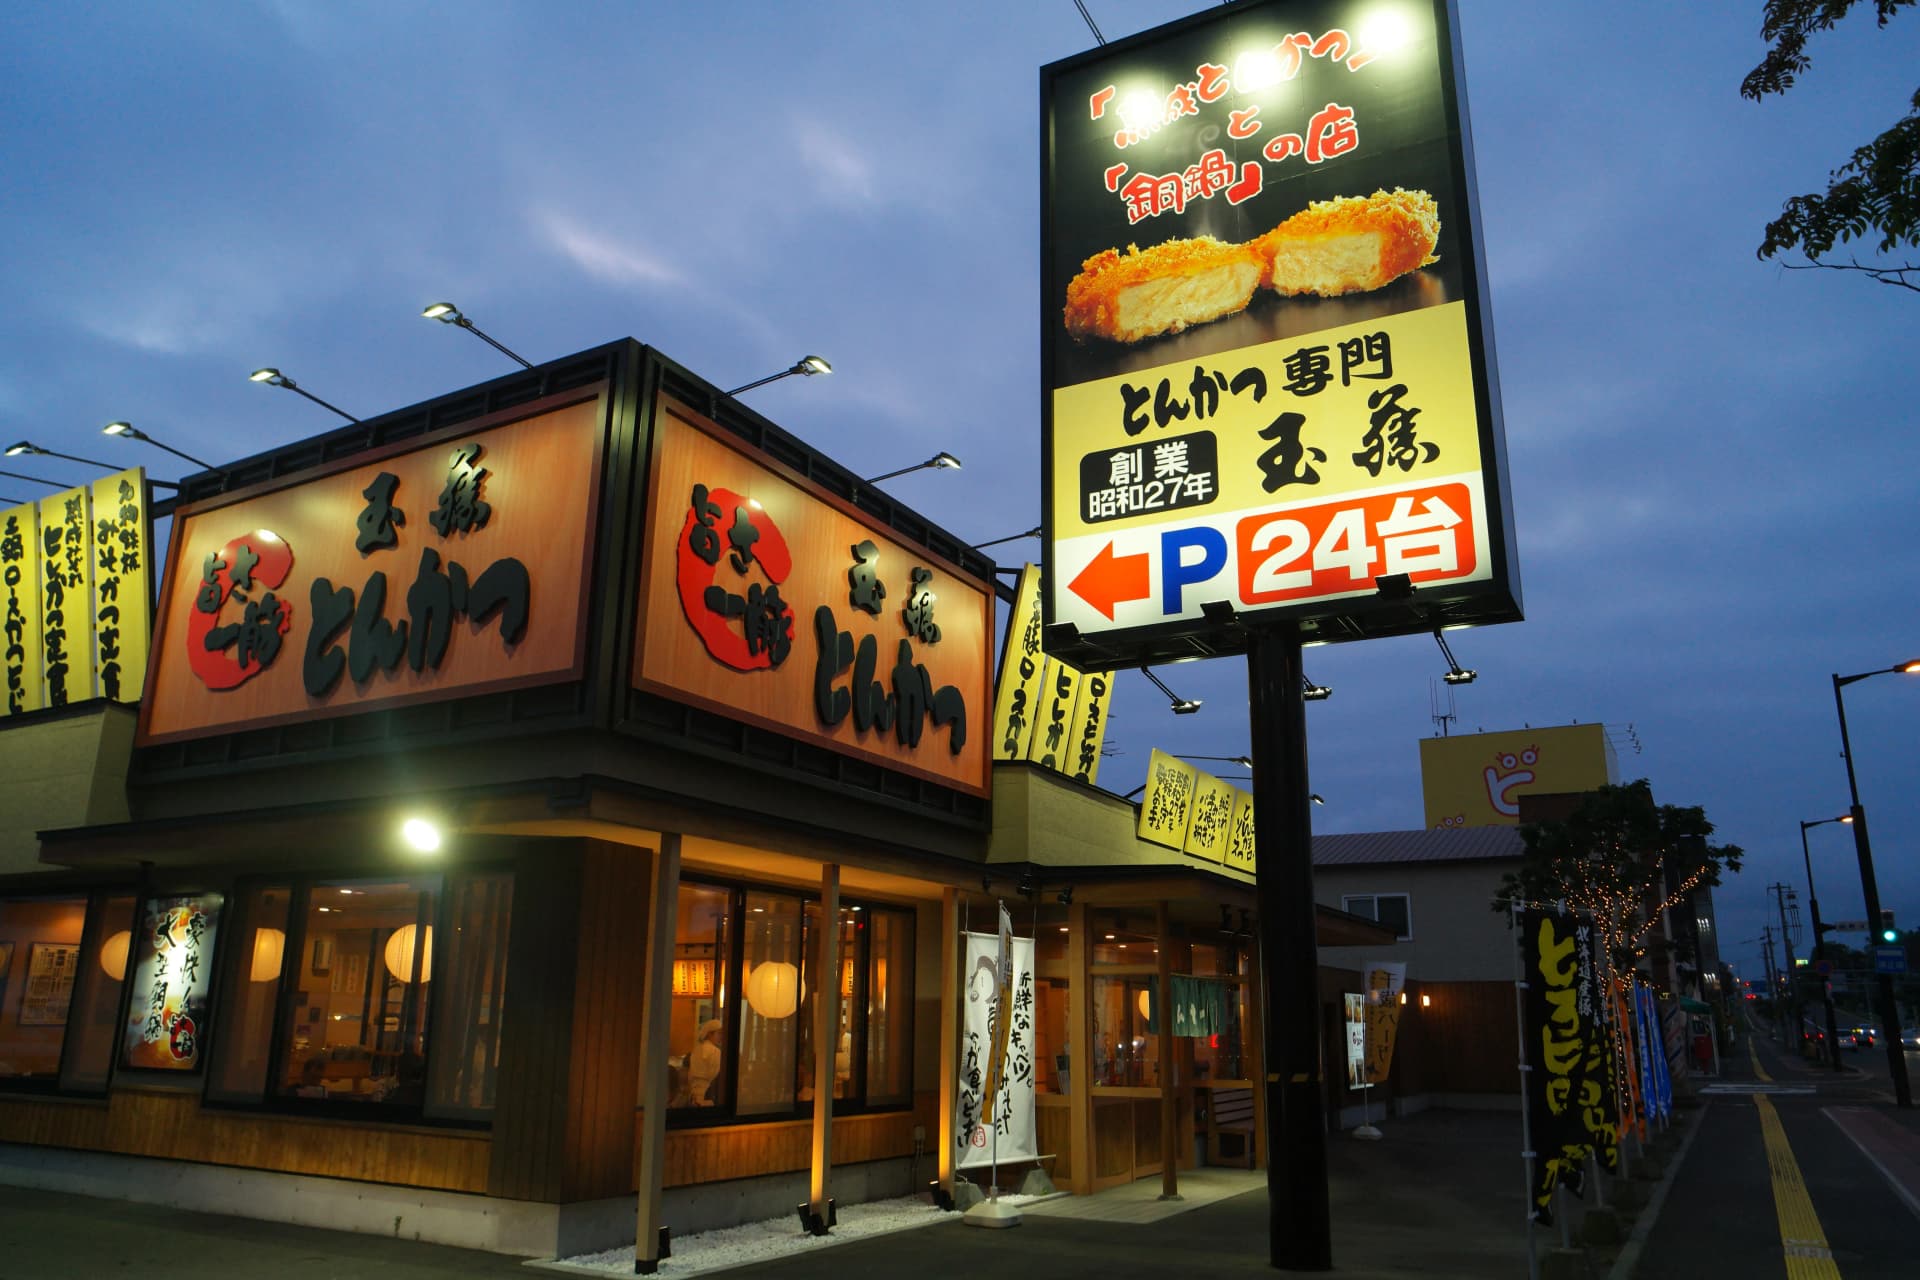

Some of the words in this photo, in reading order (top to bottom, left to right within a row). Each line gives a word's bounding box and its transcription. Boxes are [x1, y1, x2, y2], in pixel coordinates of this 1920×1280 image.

[1088, 472, 1213, 519] 昭和27年
[1109, 441, 1190, 487] 創業
[1161, 526, 1228, 616] P
[1250, 496, 1464, 594] 24台
[303, 547, 531, 698] とんかつ
[814, 605, 967, 756] とんかつ
